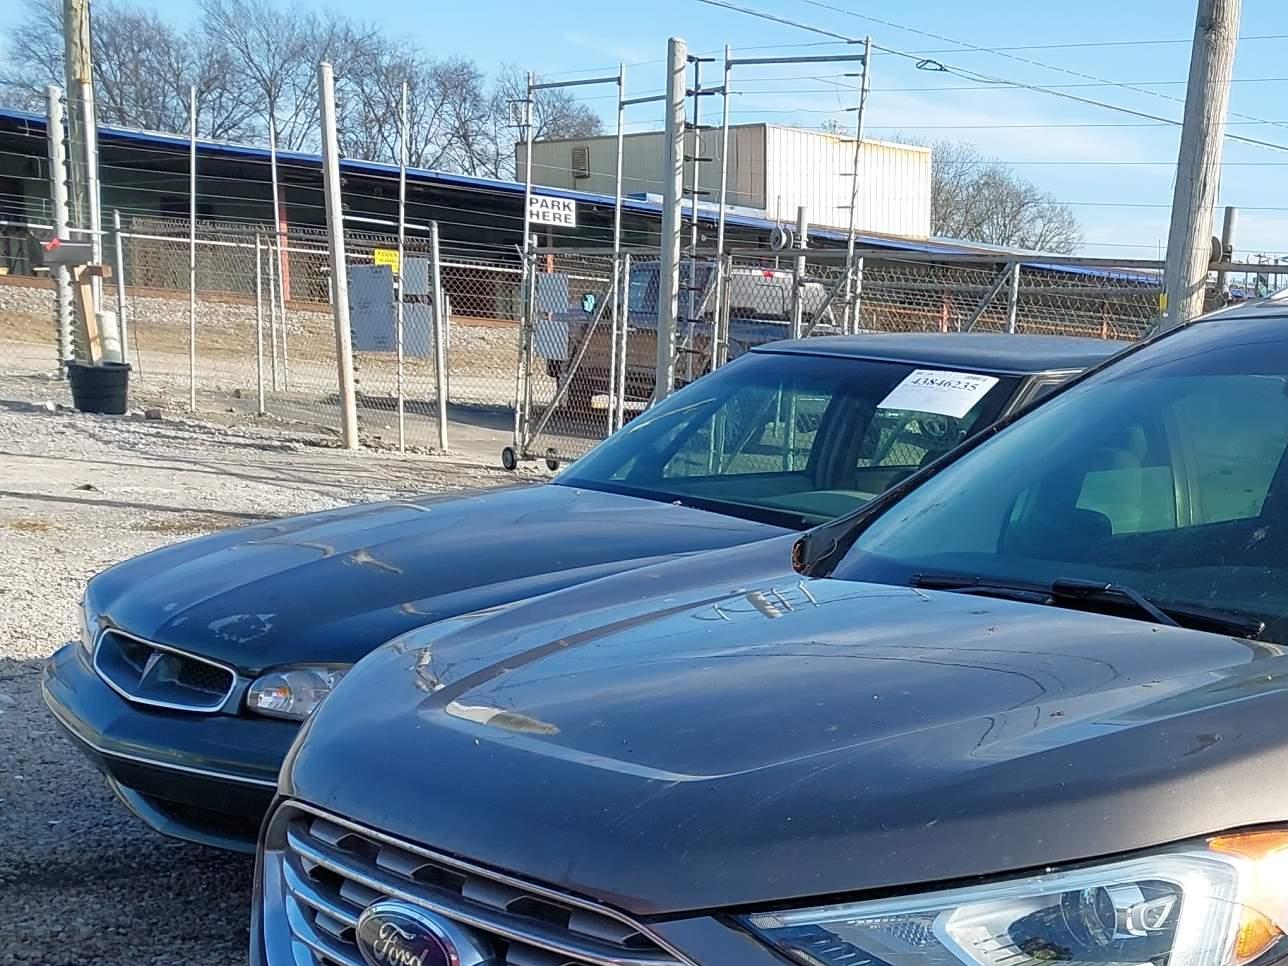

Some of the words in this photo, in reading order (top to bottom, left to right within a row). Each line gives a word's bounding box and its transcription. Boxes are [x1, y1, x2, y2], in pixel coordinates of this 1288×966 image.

[529, 197, 573, 212] PARK
[529, 210, 574, 224] HERE
[911, 377, 980, 391] 43846235
